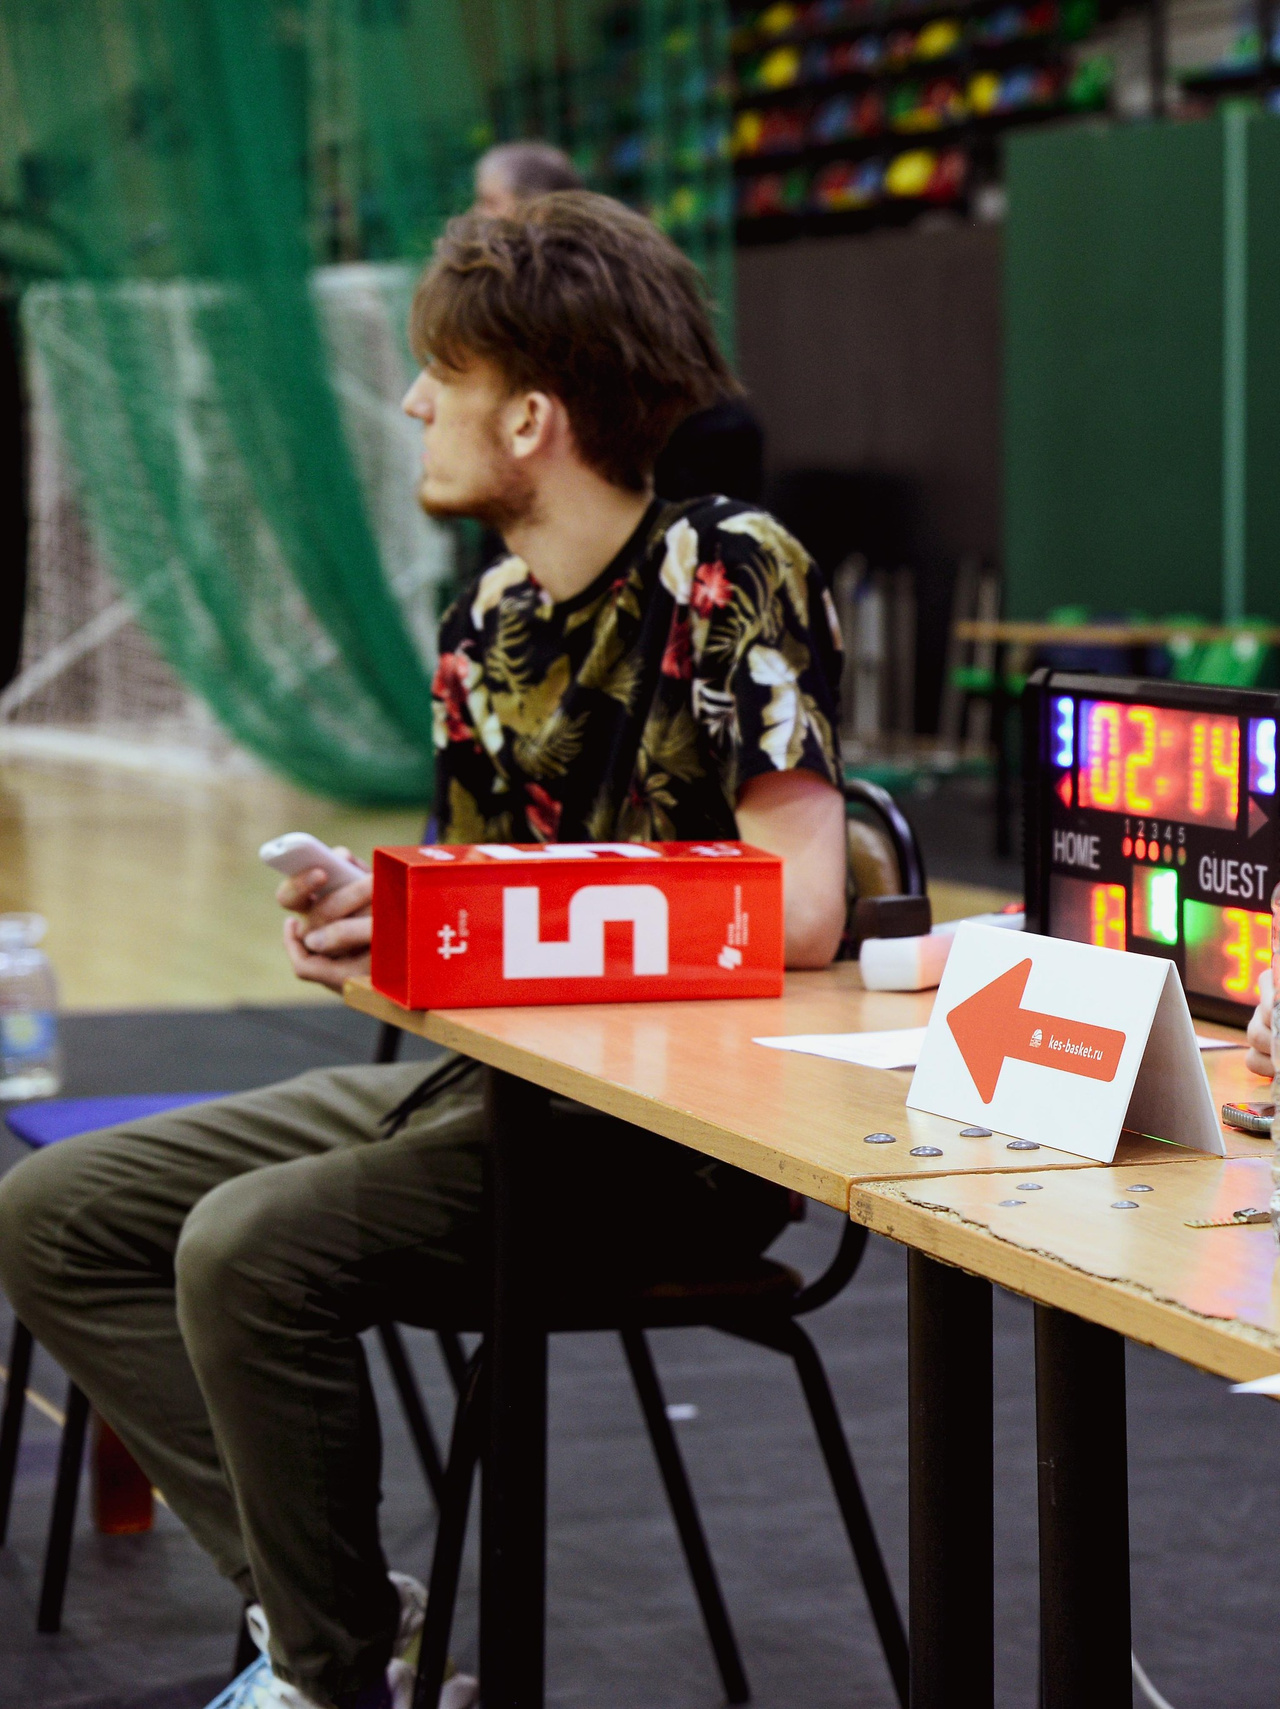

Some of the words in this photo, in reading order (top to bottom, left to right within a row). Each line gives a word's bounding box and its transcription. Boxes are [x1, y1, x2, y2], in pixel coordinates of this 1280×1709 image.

[1092, 705, 1240, 816] 02:14
[1053, 830, 1101, 871] HOME
[1138, 820, 1145, 837] 2
[1151, 822, 1158, 839] 3
[1164, 825, 1172, 841] 4
[1178, 826, 1185, 844] 5
[1199, 855, 1268, 901] GUEST
[503, 884, 668, 980] 5
[1048, 1034, 1103, 1060] kes-basket.ru
